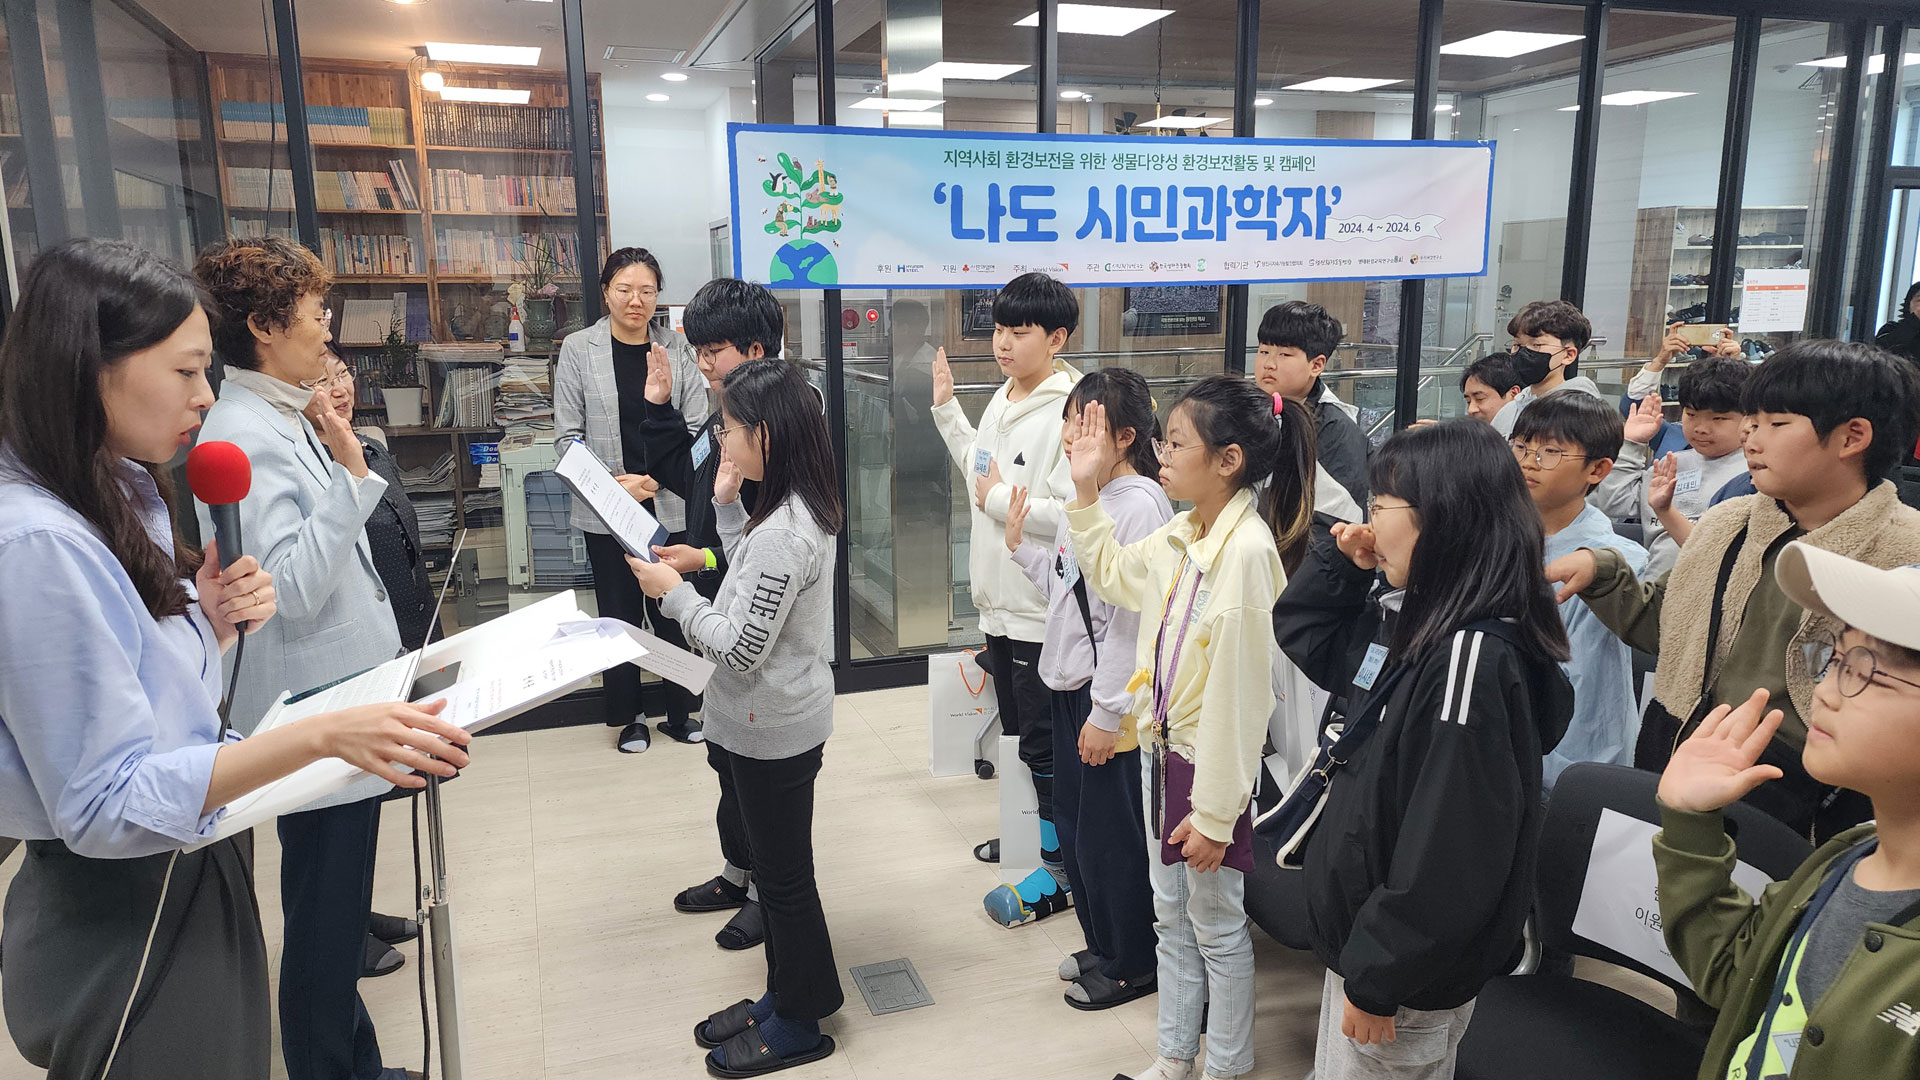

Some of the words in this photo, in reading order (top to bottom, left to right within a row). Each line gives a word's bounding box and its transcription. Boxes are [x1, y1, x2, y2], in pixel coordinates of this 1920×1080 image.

[944, 149, 1000, 169] 지역사회
[1005, 151, 1075, 170] 환경보전을
[1079, 152, 1107, 170] 위한
[1111, 153, 1178, 171] 생물다양성
[1182, 154, 1259, 172] 환경보전활동
[1263, 155, 1275, 172] 및
[1279, 156, 1316, 172] 캠페인
[1338, 223, 1364, 233] 2024.
[1367, 223, 1374, 233] 4
[1386, 222, 1412, 232] 2024.
[1414, 222, 1421, 232] 6
[877, 264, 892, 273] 후원
[942, 264, 957, 273] 지원
[1013, 264, 1027, 273] 주최
[1086, 263, 1100, 272] 주관
[1223, 260, 1249, 270] 협력기관
[749, 571, 791, 621] THE
[722, 622, 770, 672] ORIG
